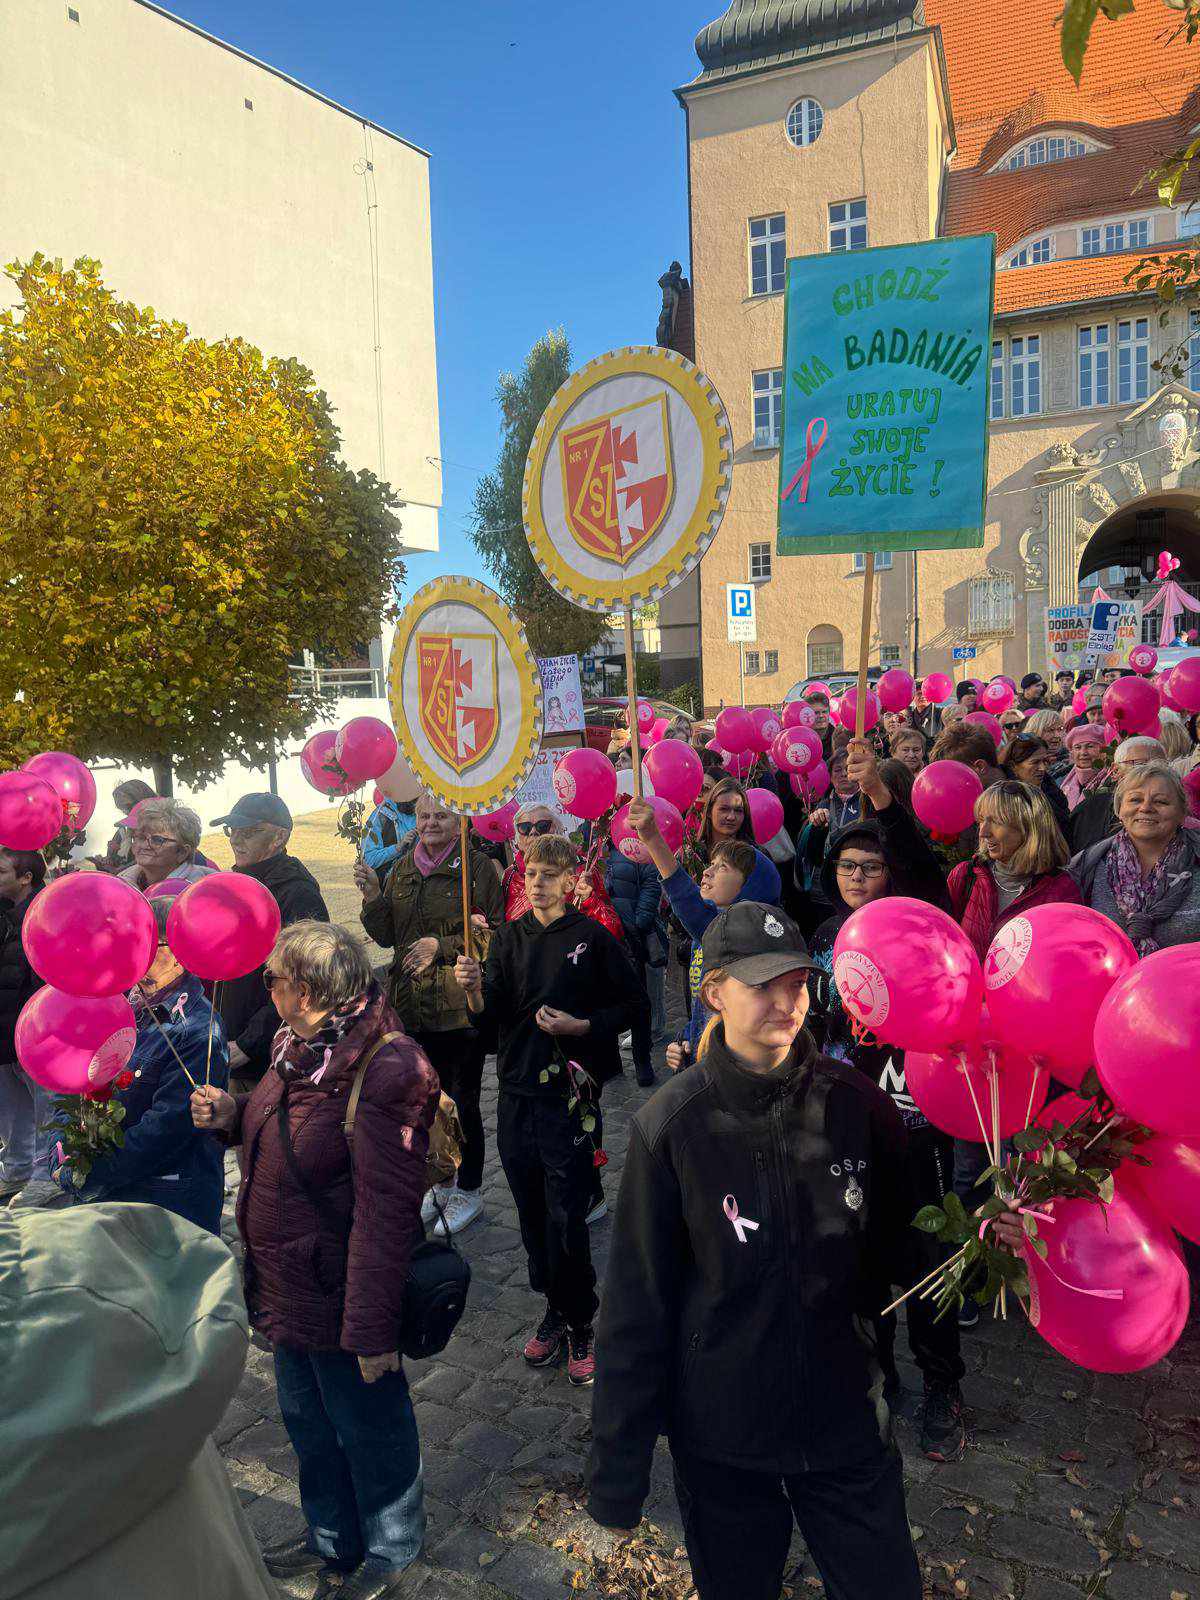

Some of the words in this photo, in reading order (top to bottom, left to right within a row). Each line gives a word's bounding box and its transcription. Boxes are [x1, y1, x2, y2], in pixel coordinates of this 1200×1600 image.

[832, 258, 950, 317] CHODŹ
[792, 354, 834, 397] NA
[847, 388, 942, 424] URATUJ
[849, 427, 930, 463] SWOJE
[828, 458, 918, 497] ŻYCIE
[735, 592, 748, 615] P
[1048, 618, 1084, 631] DOBRA
[1055, 643, 1068, 652] DO
[830, 1159, 867, 1177] OSP
